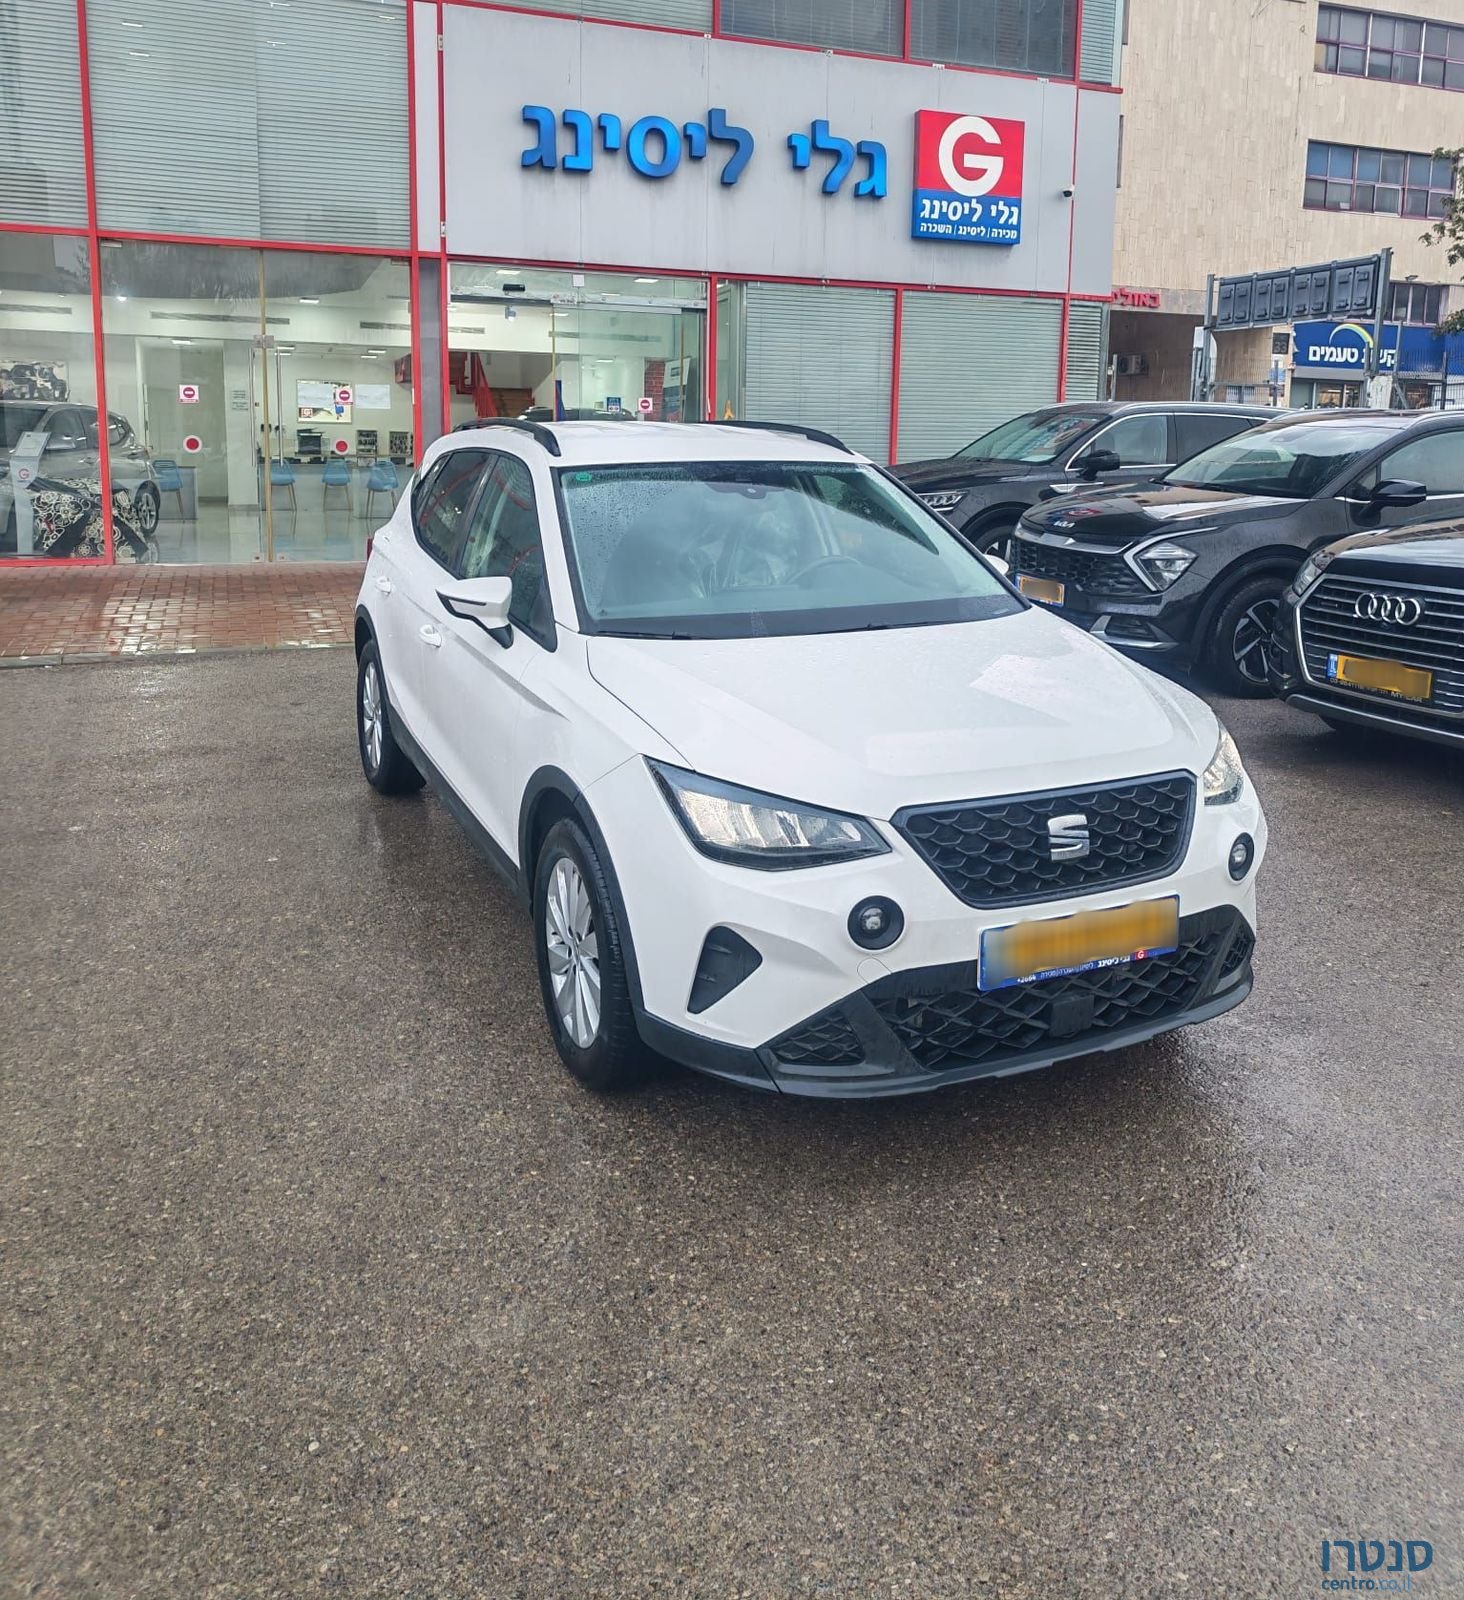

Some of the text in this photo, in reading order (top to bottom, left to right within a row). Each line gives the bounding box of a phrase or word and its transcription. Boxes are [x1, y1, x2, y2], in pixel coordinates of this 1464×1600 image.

[521, 105, 888, 197] גלי ליסינג
[938, 115, 1004, 197] G
[920, 198, 1019, 225] גלי ליסינג
[919, 222, 1018, 239] מכירה ליסינג השכרה
[1308, 345, 1359, 364] טעמים
